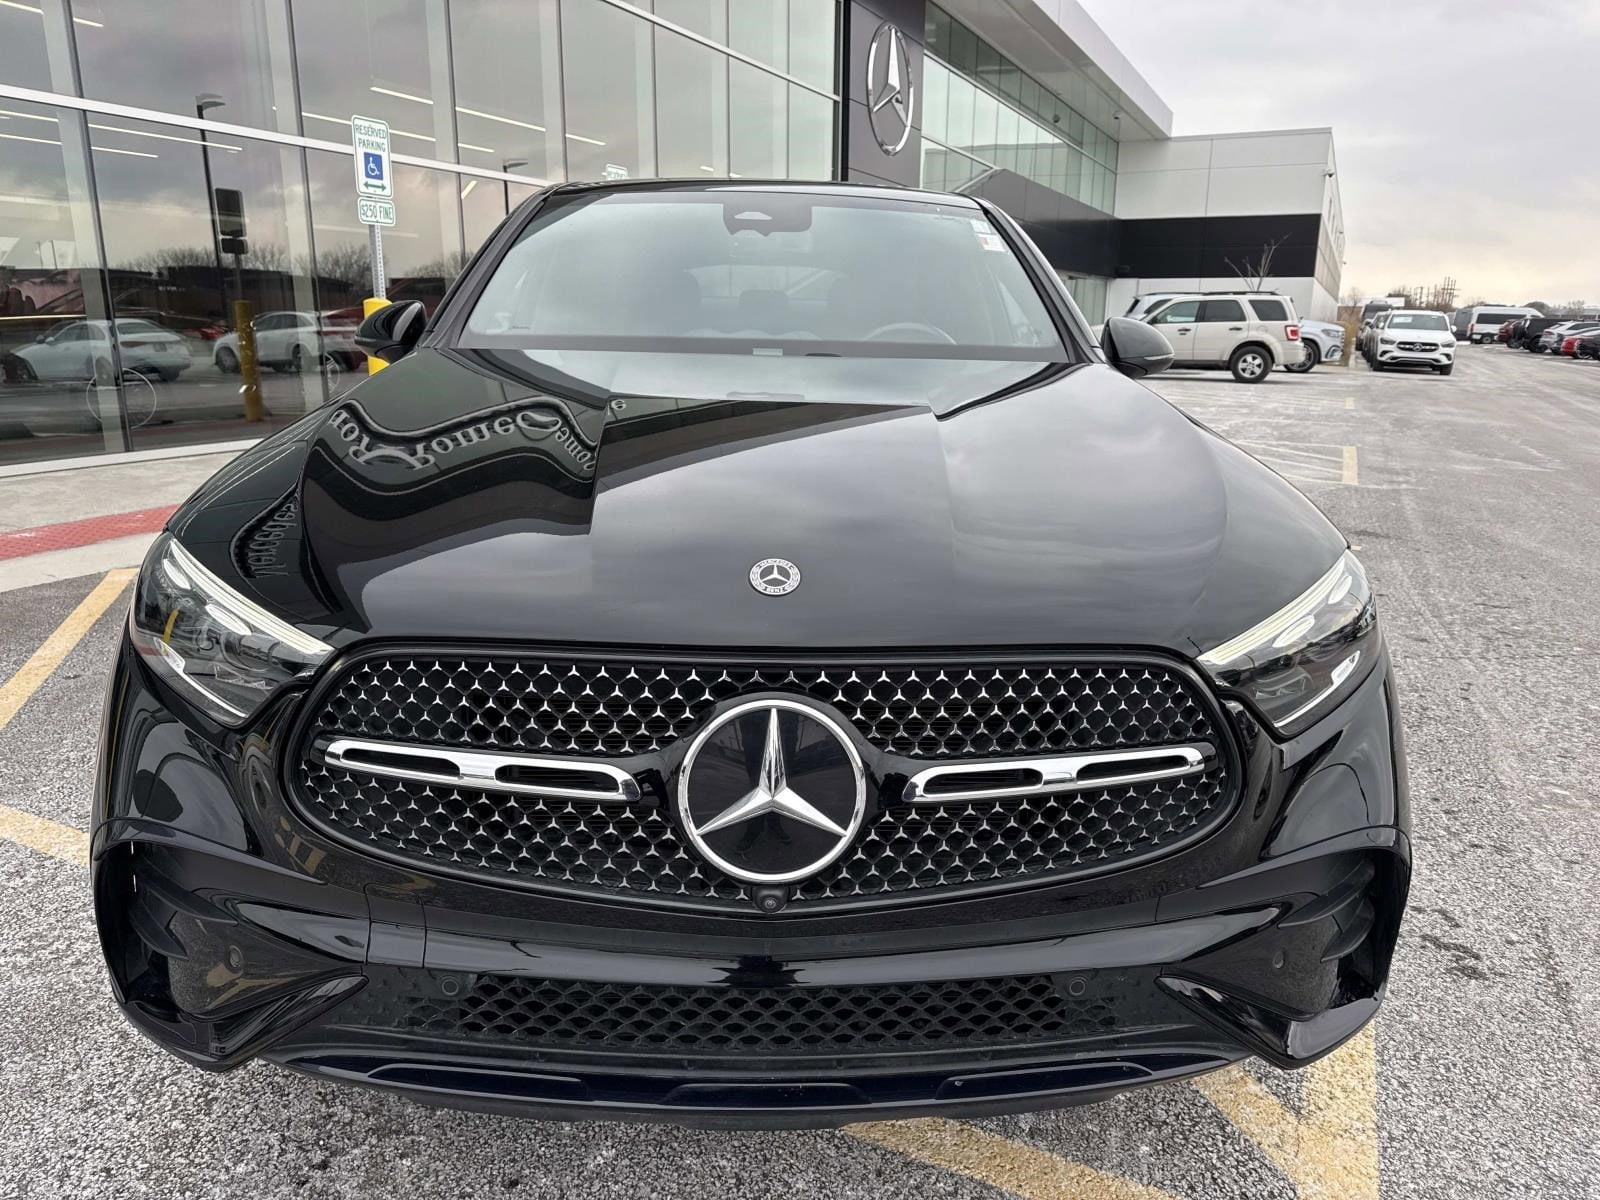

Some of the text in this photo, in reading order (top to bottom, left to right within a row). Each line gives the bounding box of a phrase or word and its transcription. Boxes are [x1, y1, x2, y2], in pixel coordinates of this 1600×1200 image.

[354, 124, 387, 140] RESERVED
[358, 138, 386, 152] PARKING
[361, 203, 393, 220] $250 FINE
